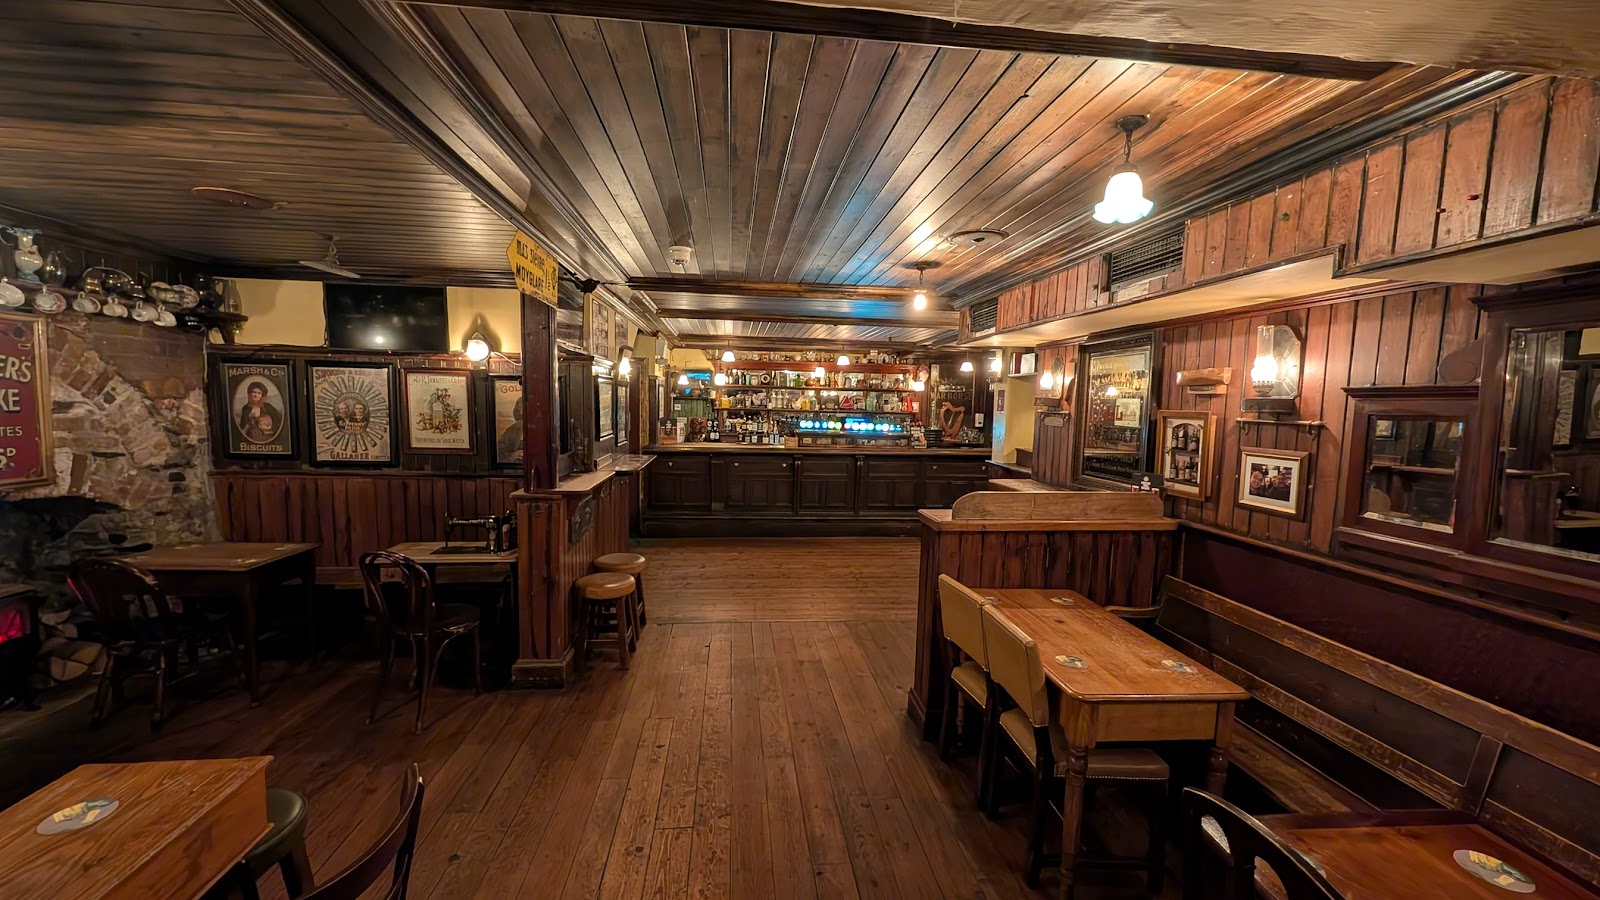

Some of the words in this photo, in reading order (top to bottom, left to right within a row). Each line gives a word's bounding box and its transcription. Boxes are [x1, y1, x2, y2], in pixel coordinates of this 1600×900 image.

[516, 262, 544, 293] MOYGLARE
[229, 366, 263, 377] MARSH
[501, 384, 522, 394] GOL
[240, 442, 283, 452] BISCUITS
[330, 450, 370, 460] GALLAHER
